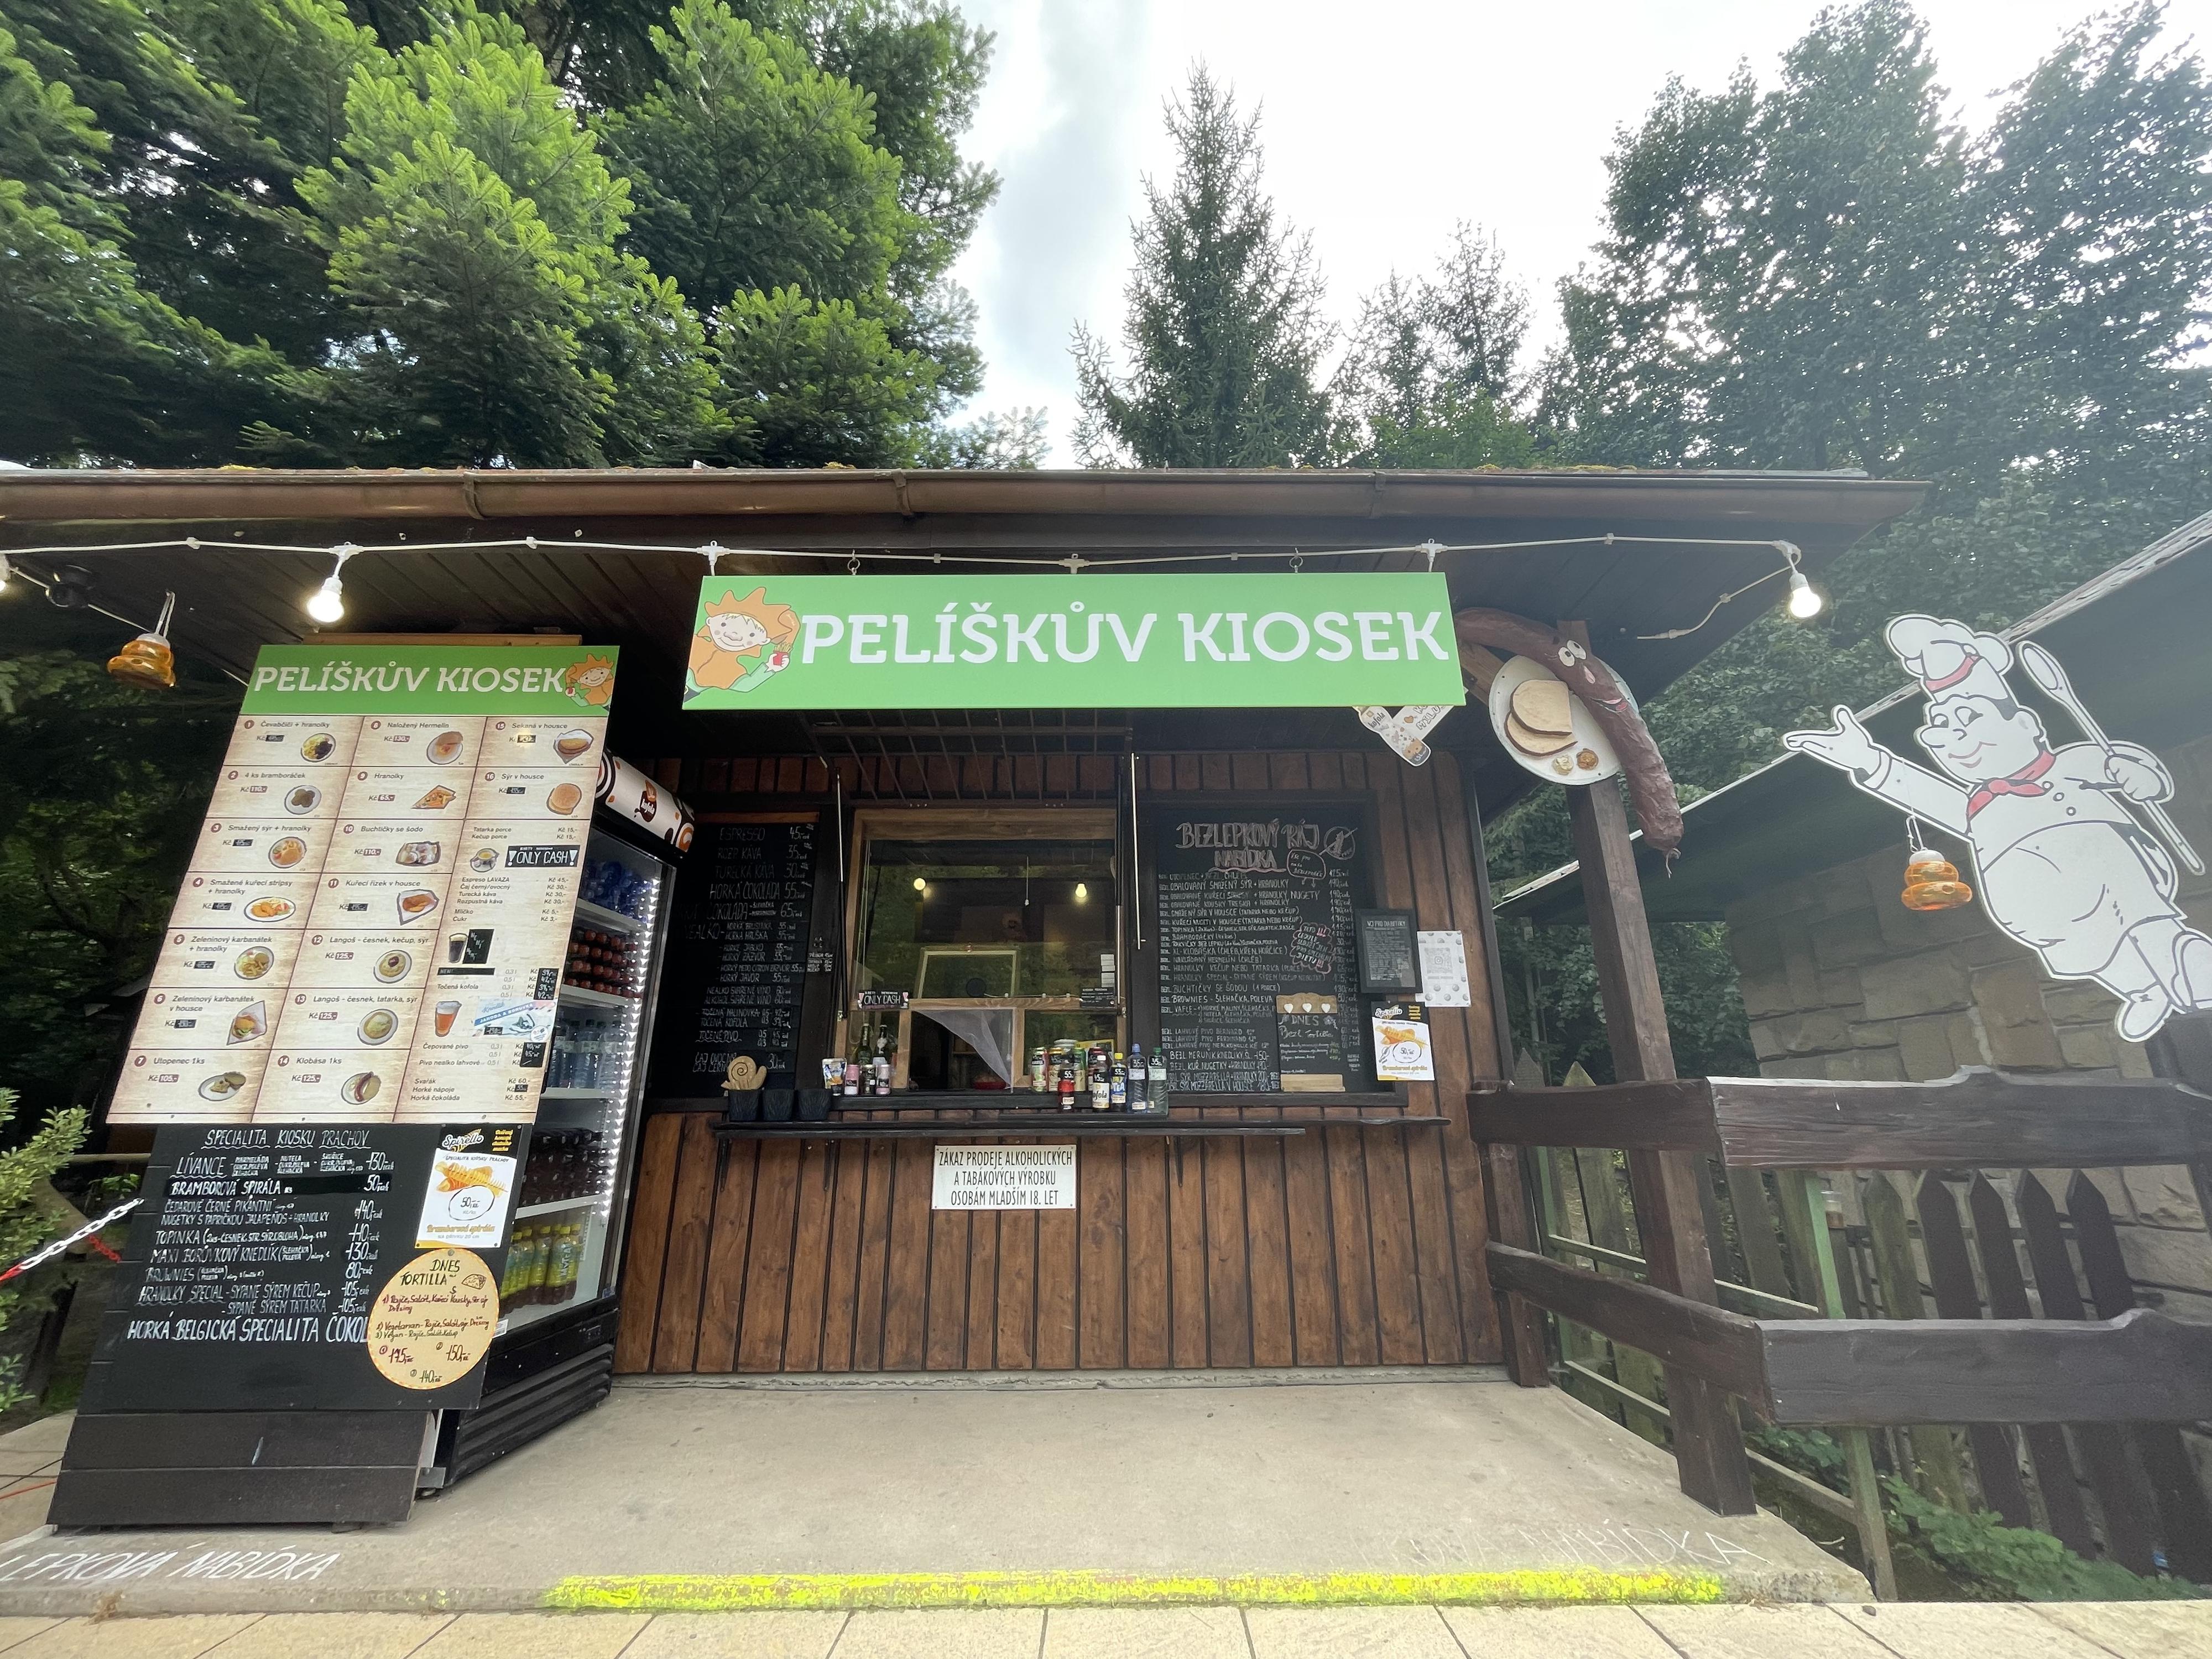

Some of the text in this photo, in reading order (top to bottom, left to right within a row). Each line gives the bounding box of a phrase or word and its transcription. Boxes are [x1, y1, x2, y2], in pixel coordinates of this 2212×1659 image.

[801, 602, 1449, 663] PELÍŠKŮV KIOSEK
[254, 661, 567, 692] PELÍŠKŮV KIOSEK
[388, 721, 418, 730] Naložený
[1368, 712, 1386, 728] kofola
[1176, 818, 1280, 848] BEZLEPKOVÝ
[173, 995, 212, 1003] Zeleninový
[204, 1129, 370, 1147] SPECIALITA KIOSKU PRACHOV
[442, 1134, 484, 1150] Spirello
[176, 1151, 227, 1176] LÍVANCE
[939, 1146, 1072, 1168] ZÁKAZ PRODEJE ALKOHOLICKÝCH
[954, 1166, 1056, 1186] A TABÁKOVÝCH VÝROBKU
[170, 1178, 281, 1196] BRAMBOROVÁ SPIRÁLA
[951, 1186, 1058, 1206] OSOBÁM MLADŠÍM 18. LET
[156, 1230, 200, 1245] TOPINKA
[429, 1259, 460, 1272] DNES
[400, 1272, 447, 1286] TORTILLA
[190, 1285, 224, 1300] SPECIAL
[127, 1311, 174, 1340] HORKÁ
[171, 1315, 242, 1341] BELGICKÁ
[239, 1317, 319, 1342] SPECIALITA
